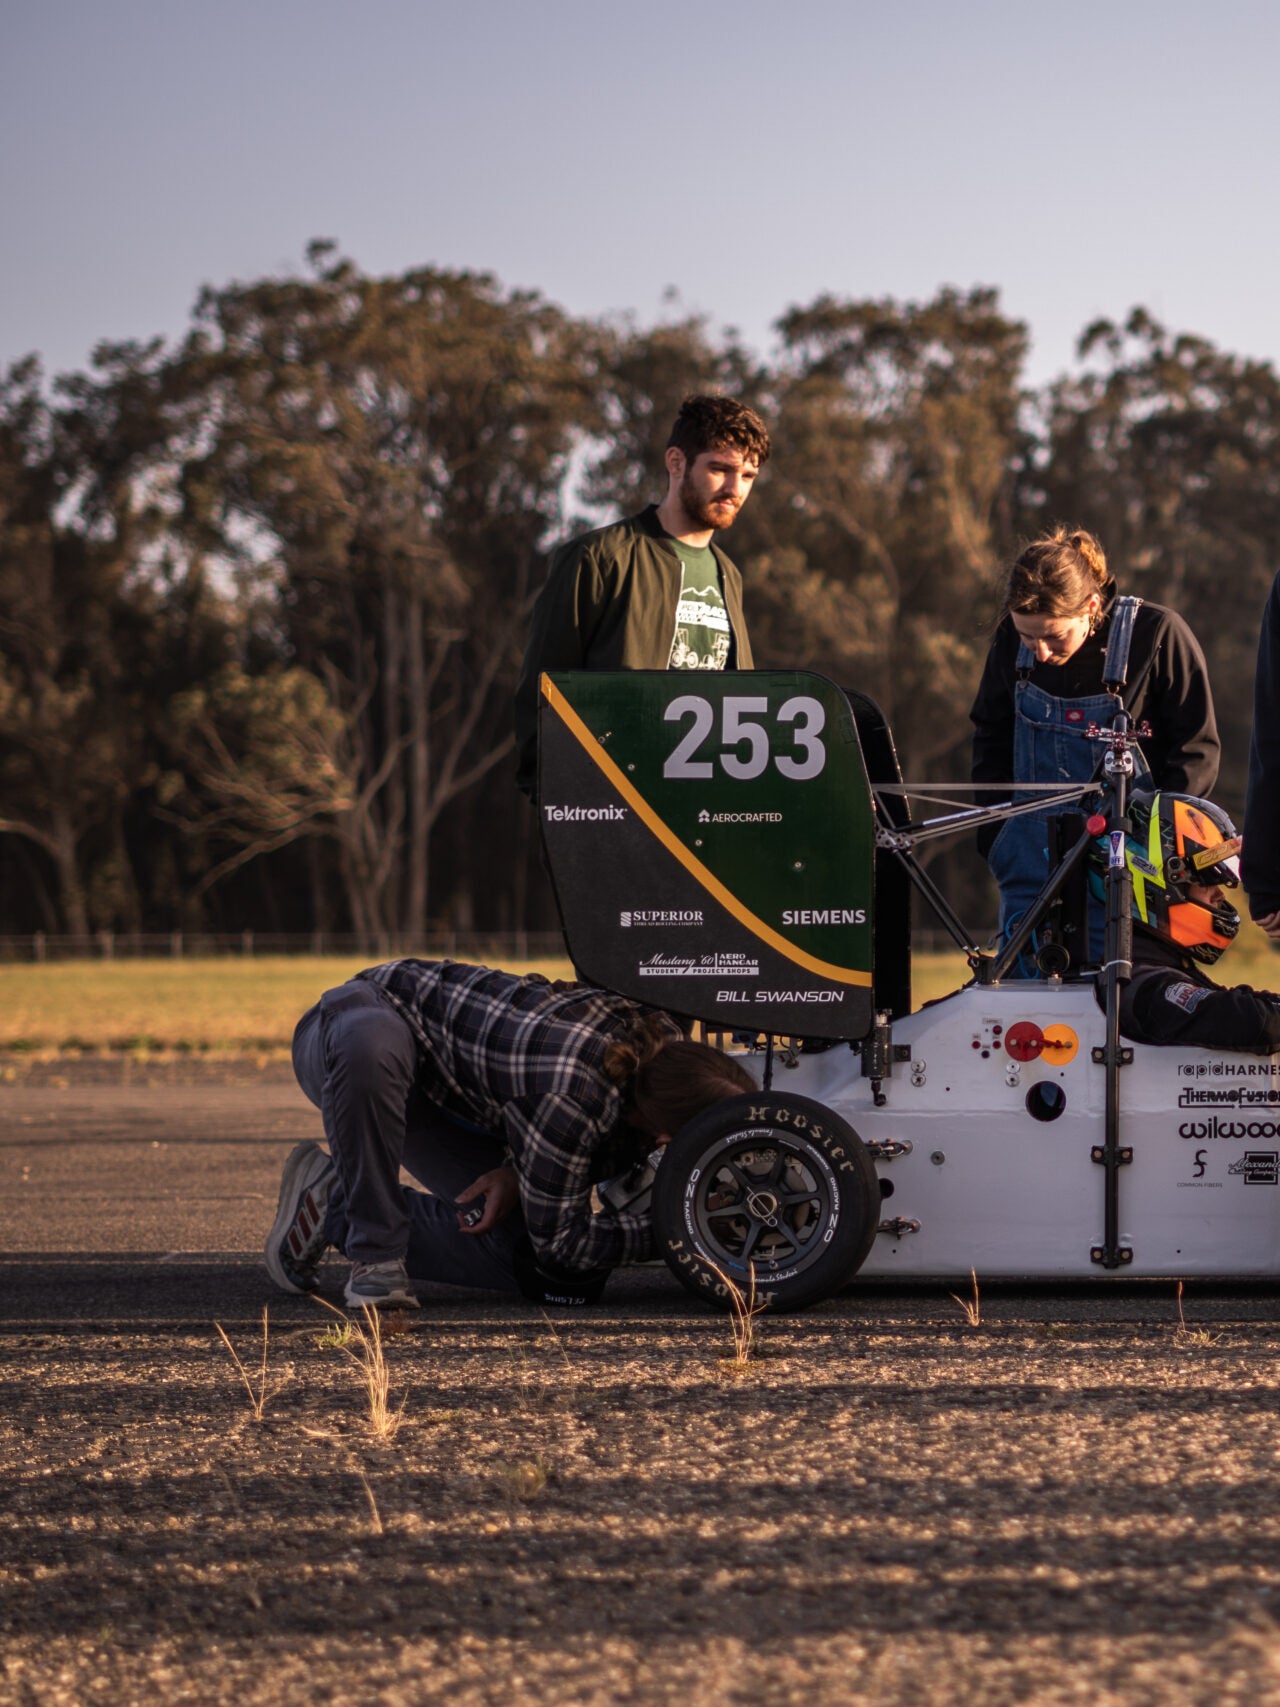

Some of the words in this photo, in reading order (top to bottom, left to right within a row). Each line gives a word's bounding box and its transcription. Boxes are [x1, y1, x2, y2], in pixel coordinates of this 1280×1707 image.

[663, 695, 826, 781] 253
[544, 804, 625, 821] Tektronix
[712, 813, 782, 823] AEROCRAFTED
[633, 910, 704, 921] SUPERIOR
[782, 910, 866, 926] SIEMENS
[639, 953, 696, 972] Mustang
[715, 991, 750, 1002] BILL
[754, 991, 844, 1002] SWANSON
[744, 1106, 855, 1173] Hoosier
[830, 1177, 840, 1210] RACING
[684, 1201, 694, 1234] RACING
